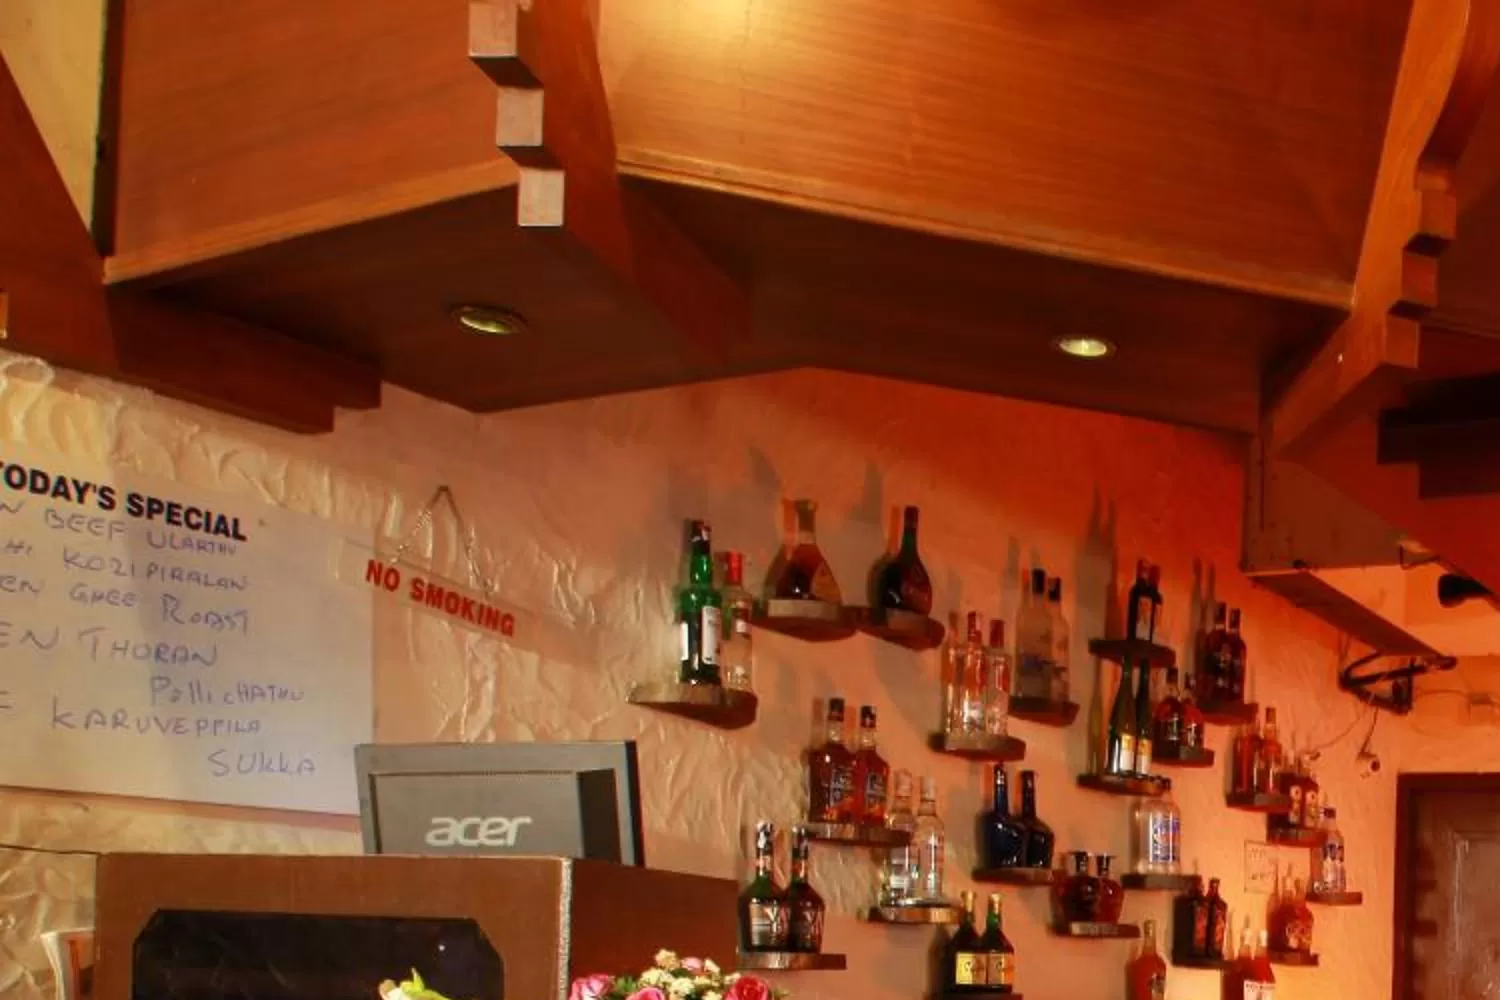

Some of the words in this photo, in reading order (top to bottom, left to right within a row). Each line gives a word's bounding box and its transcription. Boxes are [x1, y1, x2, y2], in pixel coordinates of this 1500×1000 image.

[0, 461, 116, 511] ODAY'S
[125, 493, 247, 541] SPECIAL
[44, 507, 128, 541] BEEF
[69, 582, 140, 607] GHEE
[366, 559, 400, 592] NO
[409, 577, 515, 638] SMOKING
[78, 626, 218, 667] THORAN
[425, 816, 532, 847] acer
